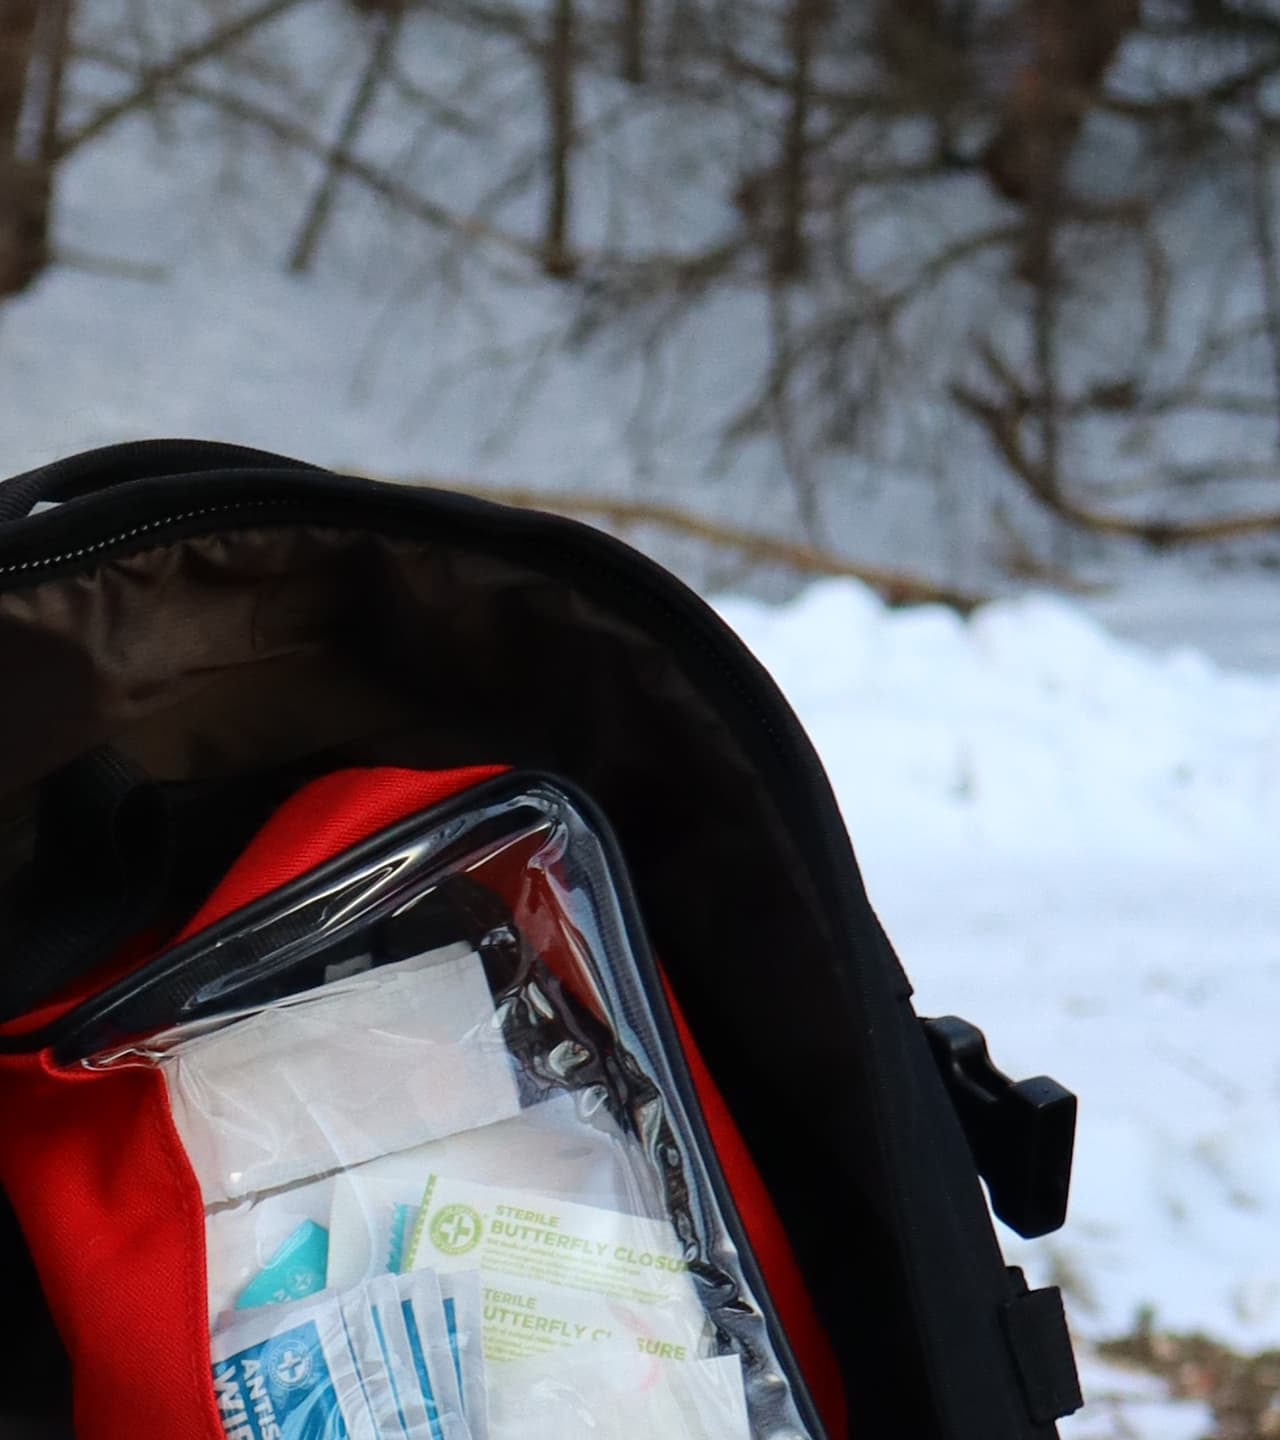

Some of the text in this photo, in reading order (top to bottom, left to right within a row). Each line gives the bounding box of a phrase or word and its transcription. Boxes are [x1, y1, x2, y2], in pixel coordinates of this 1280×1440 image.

[495, 1205, 561, 1229] STERILE
[490, 1219, 608, 1256] BUTTERFLY
[614, 1246, 689, 1273] CLOSU
[482, 1287, 536, 1309] TERILE
[483, 1306, 587, 1339] UTTERFLY
